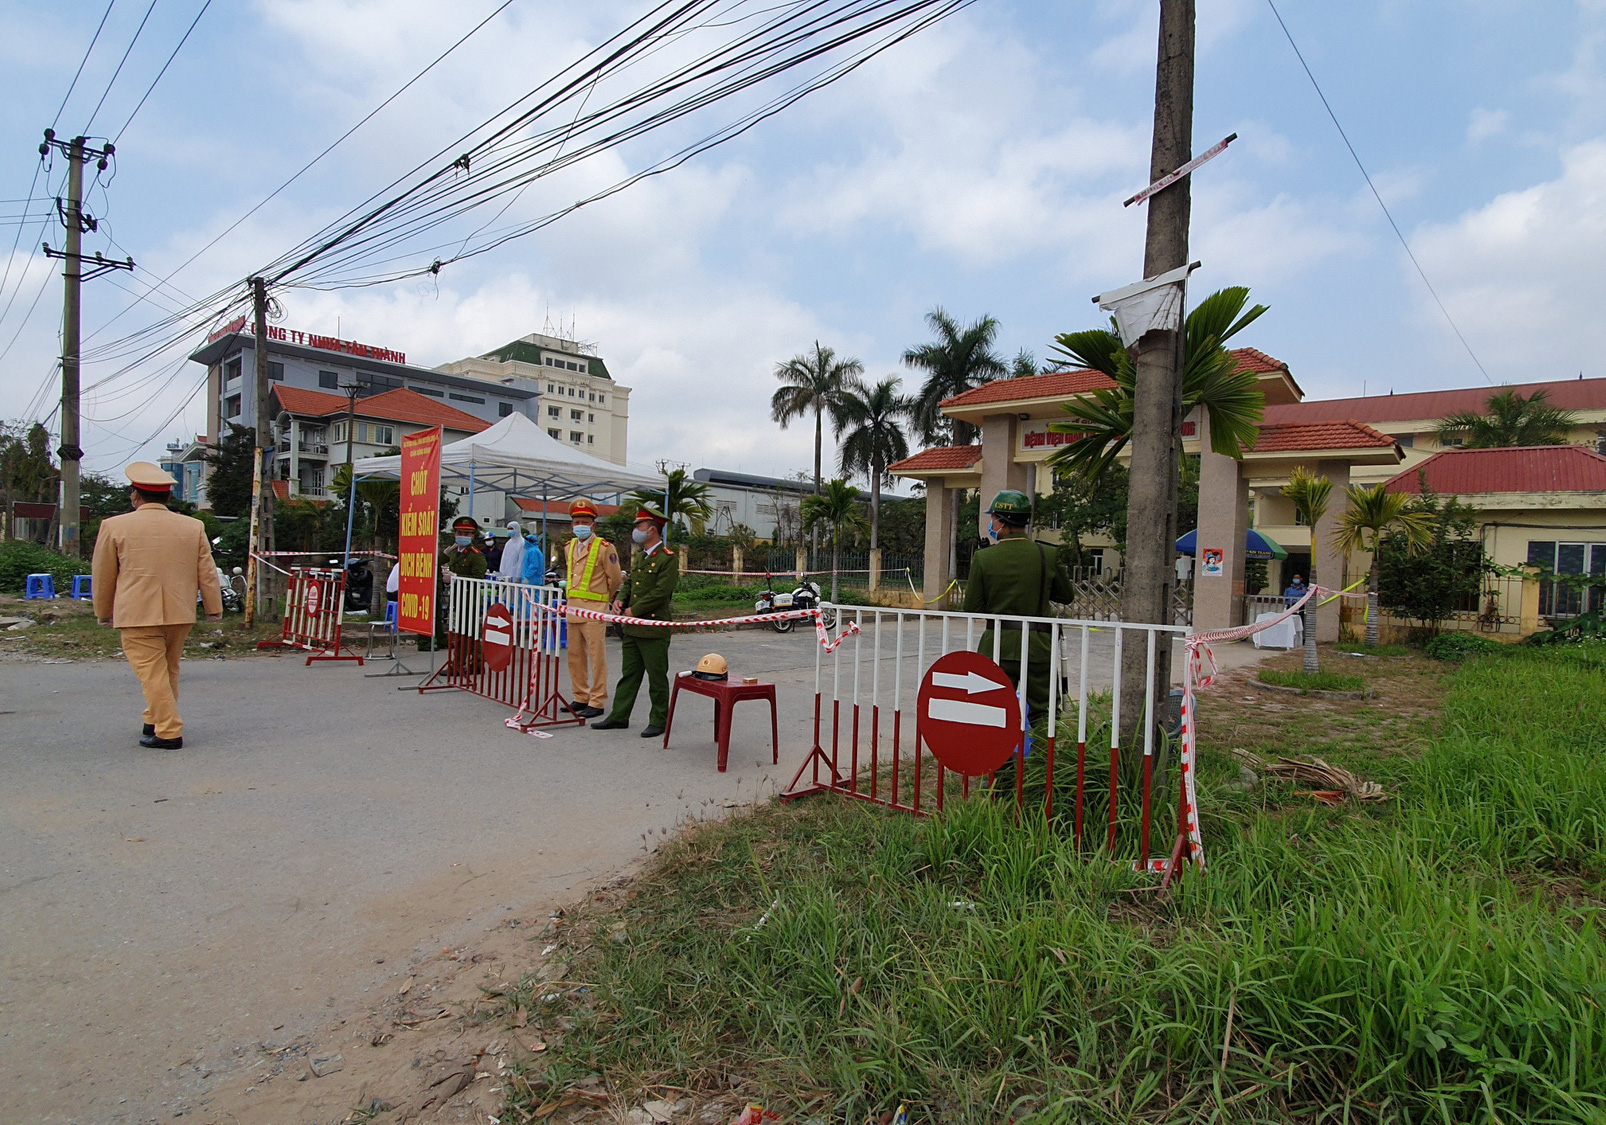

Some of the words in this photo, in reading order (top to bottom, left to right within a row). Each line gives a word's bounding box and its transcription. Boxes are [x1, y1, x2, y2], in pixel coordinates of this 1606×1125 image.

[251, 322, 286, 341] CNG
[290, 330, 304, 345] TY
[344, 340, 367, 357] TÂN
[370, 346, 406, 365] THÀNH
[411, 461, 428, 496] CHỐT
[401, 502, 417, 536] KIỂM
[418, 505, 434, 536] SOÁT
[401, 552, 415, 582] DỊCH
[416, 547, 432, 583] BỆNH
[402, 592, 418, 619] COVID
